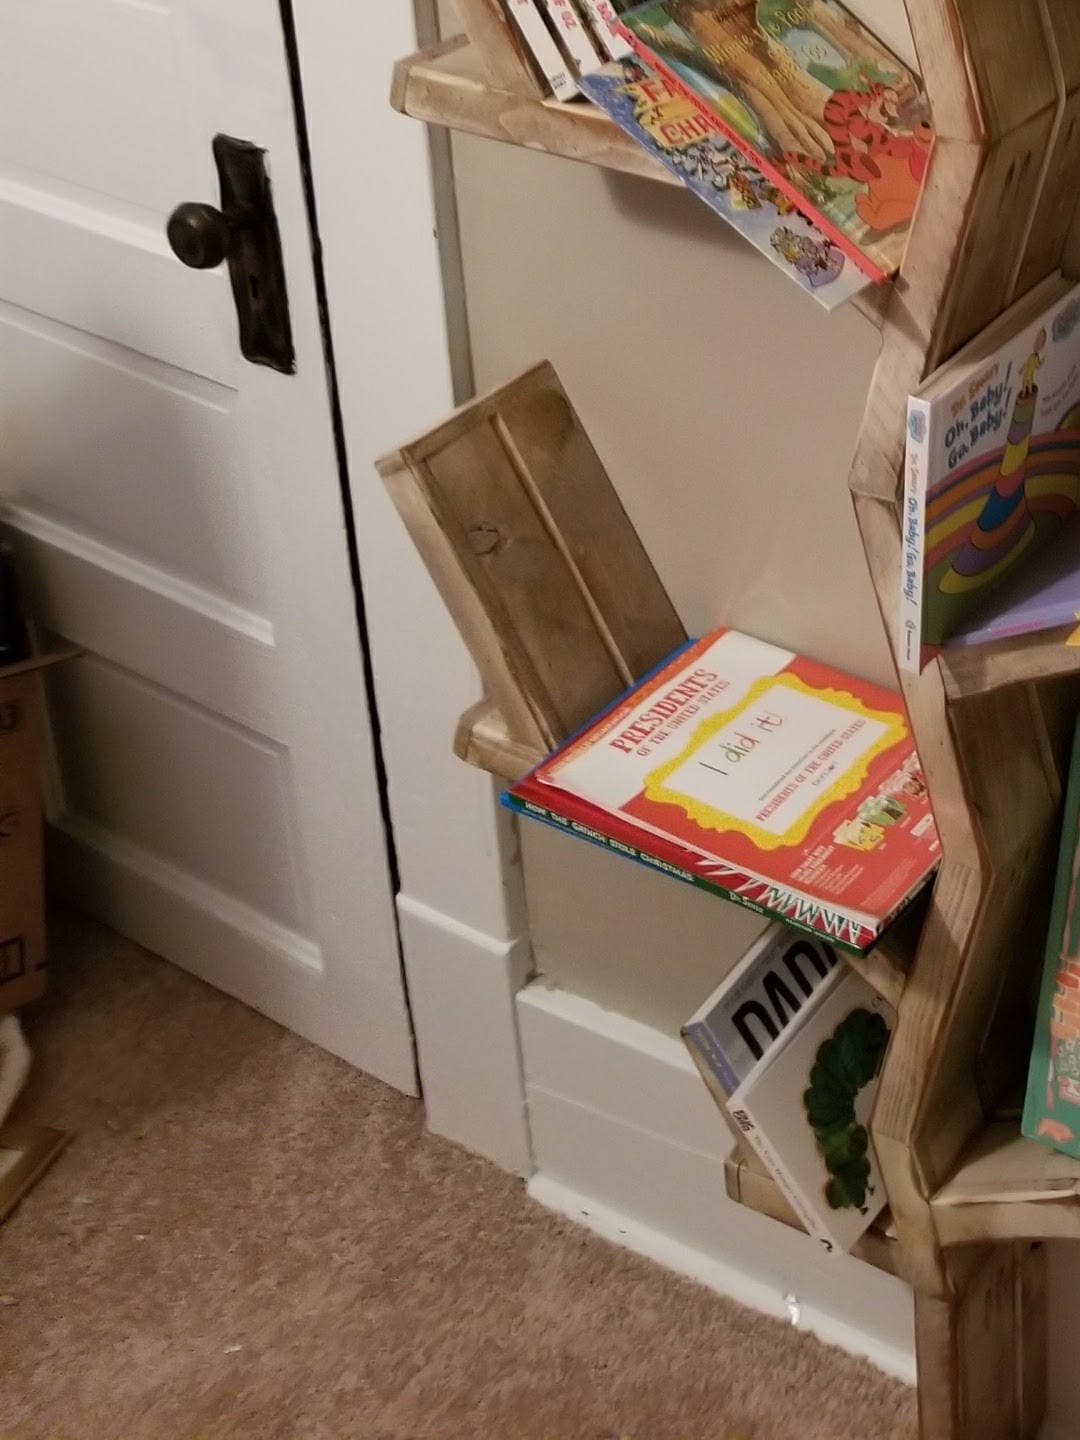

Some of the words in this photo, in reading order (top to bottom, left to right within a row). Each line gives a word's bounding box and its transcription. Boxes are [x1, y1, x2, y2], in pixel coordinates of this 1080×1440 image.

[561, 10, 577, 30] OZ
[608, 668, 718, 753] PRESIDENTS
[636, 743, 651, 757] OF
[649, 729, 669, 744] THE
[667, 704, 700, 730] UNITED
[719, 731, 760, 763] did
